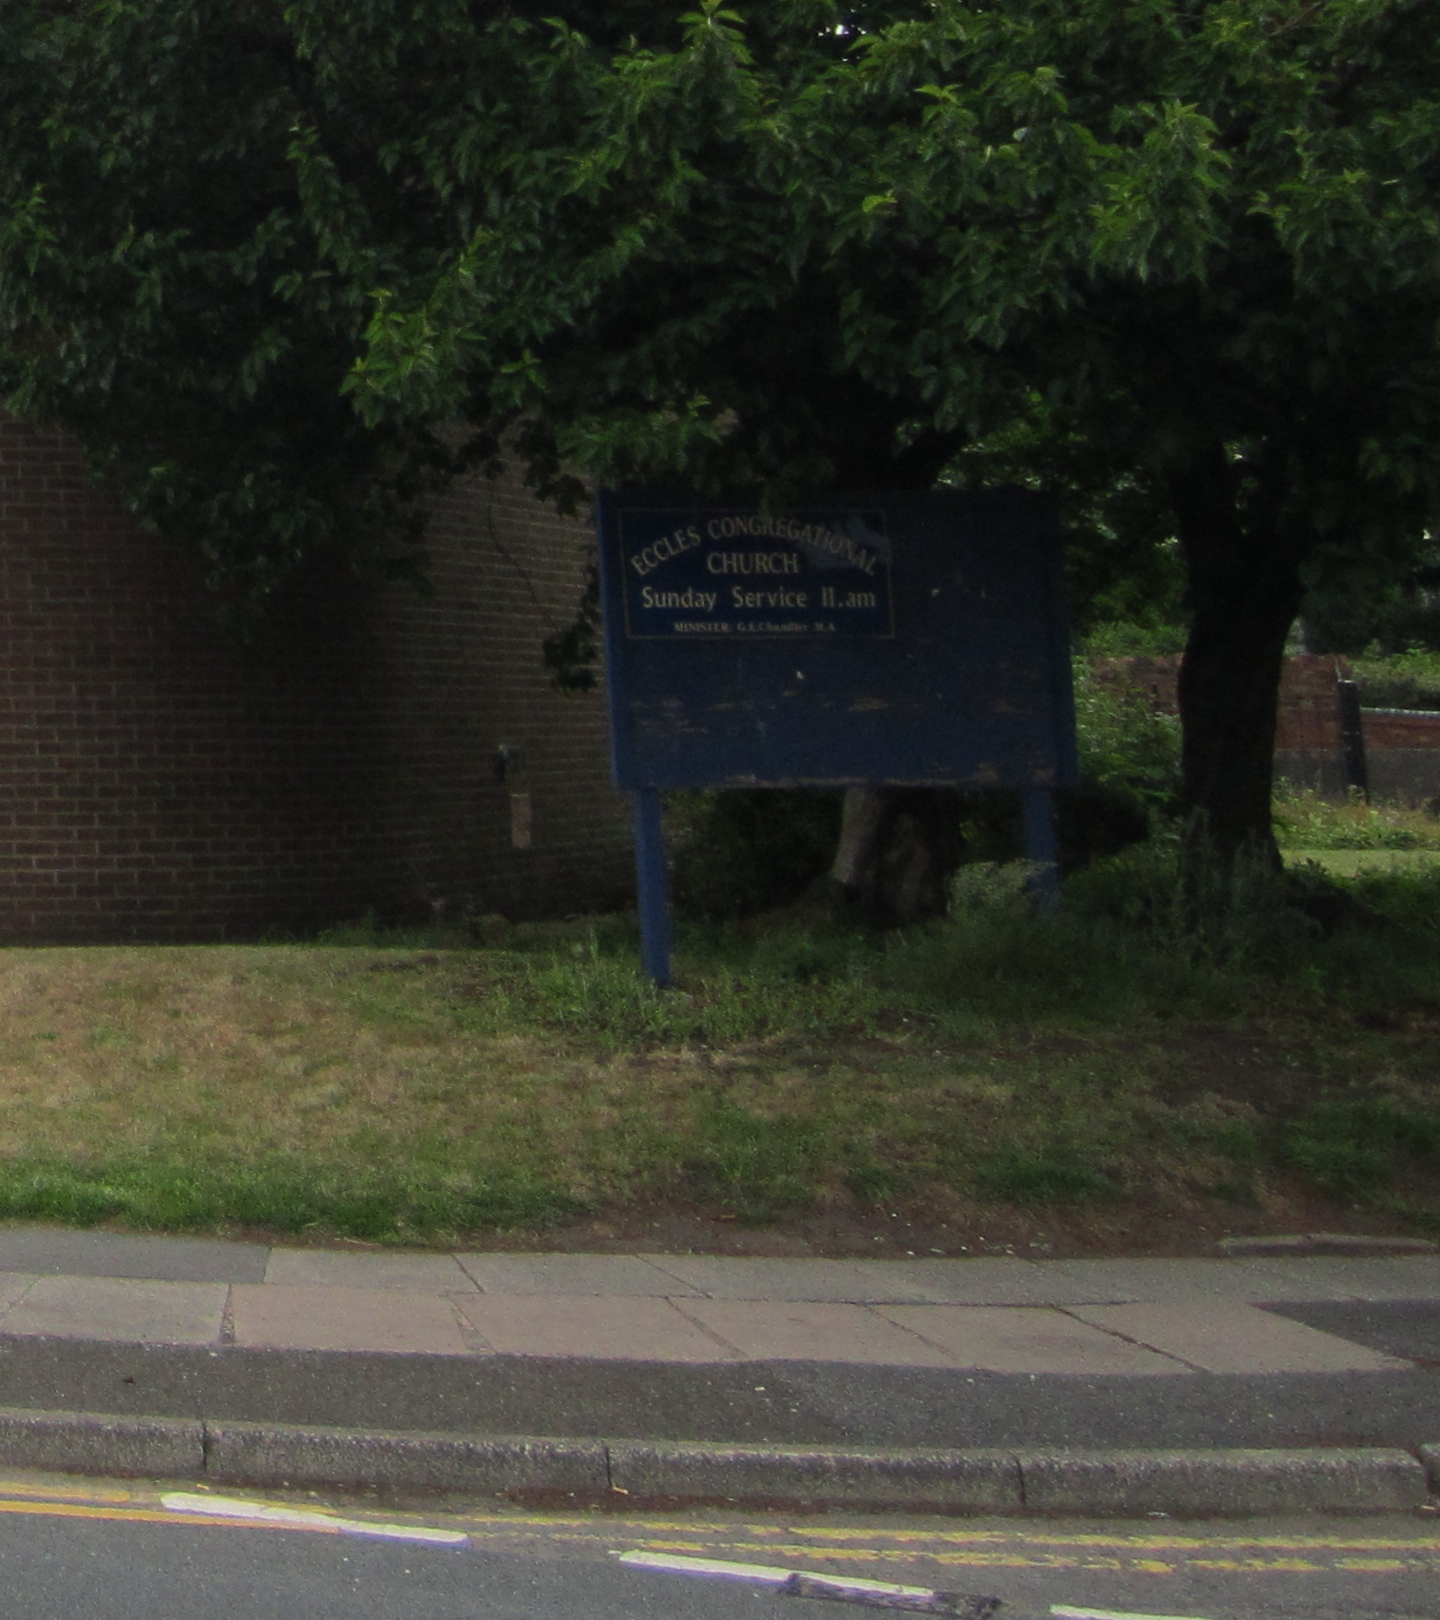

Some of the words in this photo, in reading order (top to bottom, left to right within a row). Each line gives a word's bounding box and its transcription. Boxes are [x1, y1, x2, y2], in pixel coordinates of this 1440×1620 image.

[631, 525, 702, 576] ECCLES
[707, 516, 878, 576] CONGREGATIONAL
[706, 552, 799, 574] CHURCH
[641, 586, 717, 612] Sunday
[732, 586, 808, 608] Service
